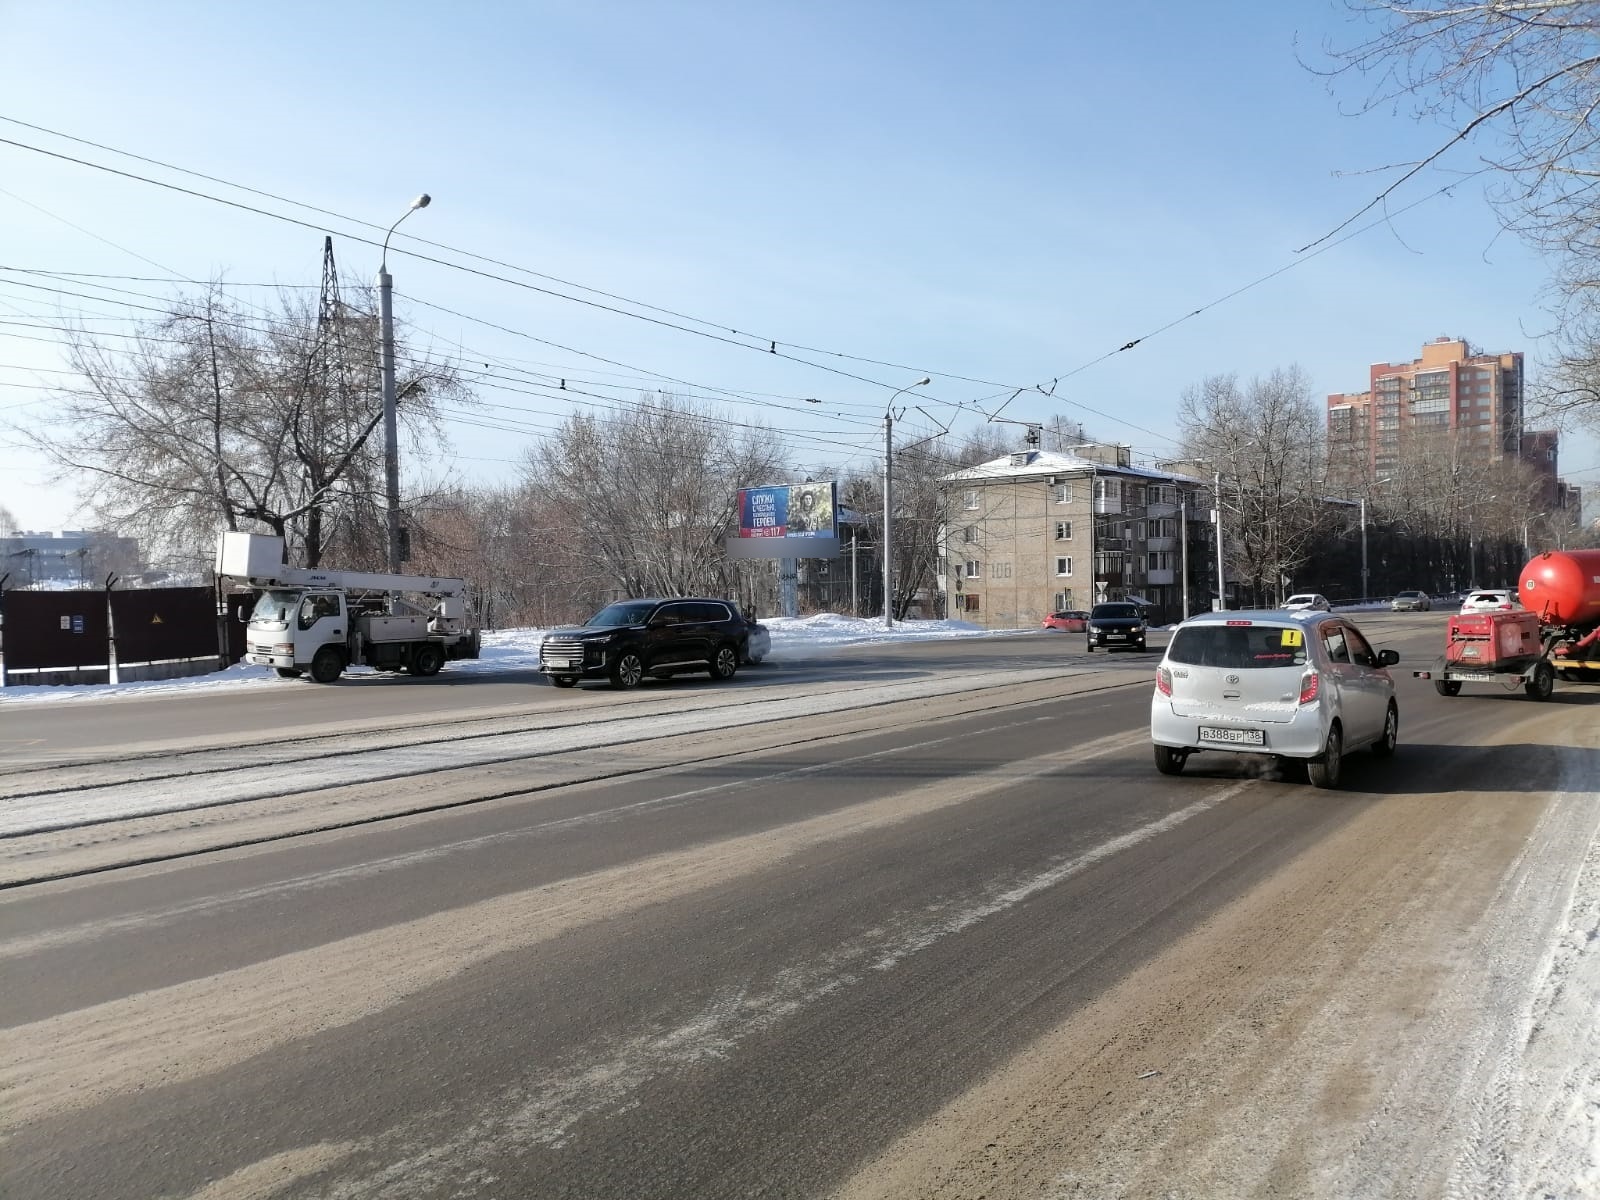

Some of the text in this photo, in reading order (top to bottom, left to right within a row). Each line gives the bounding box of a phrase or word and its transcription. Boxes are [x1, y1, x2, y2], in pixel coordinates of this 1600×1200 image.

[752, 493, 775, 505] СЛУЖИ
[771, 527, 780, 537] 117
[992, 562, 1011, 579] 106
